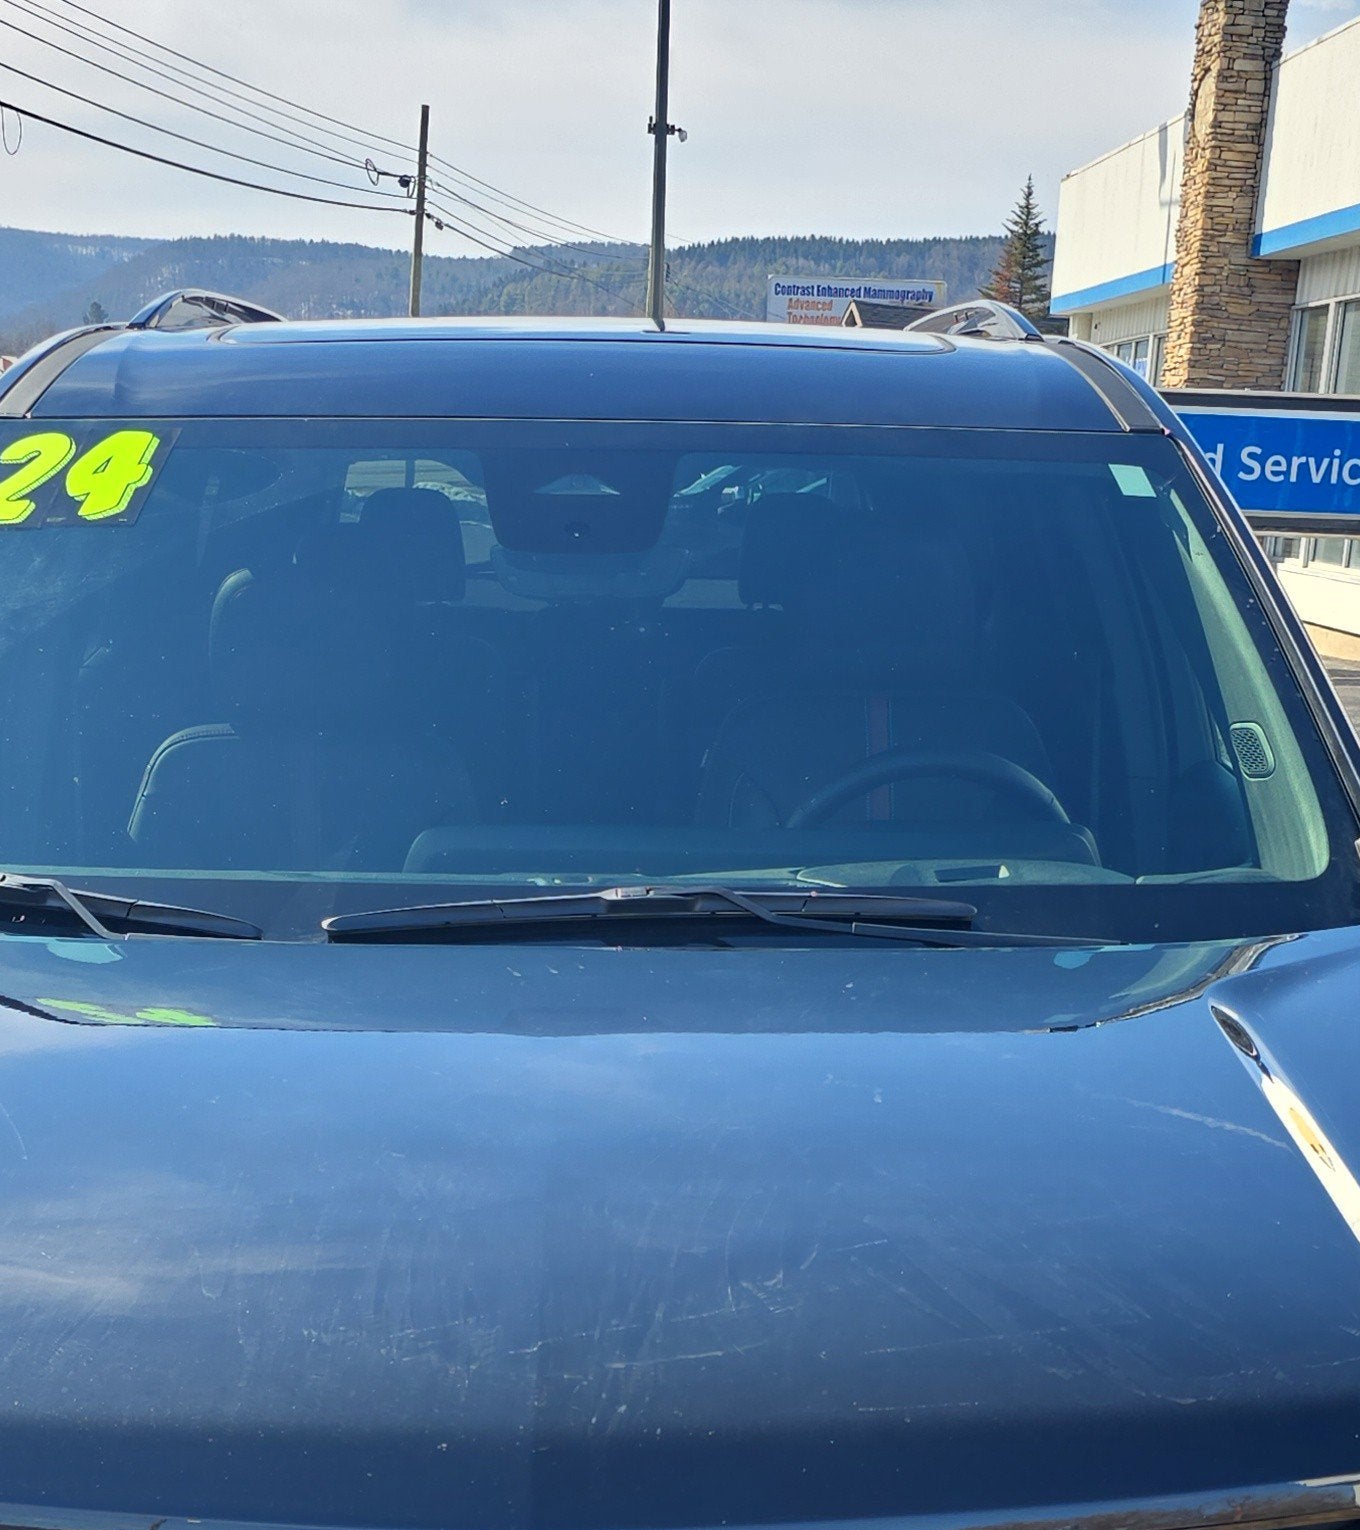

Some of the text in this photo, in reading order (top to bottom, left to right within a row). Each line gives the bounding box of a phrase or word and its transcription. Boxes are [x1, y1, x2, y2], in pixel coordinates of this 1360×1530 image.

[774, 283, 934, 303] Contrast Enhanced Mammography
[787, 299, 833, 312] Advanced
